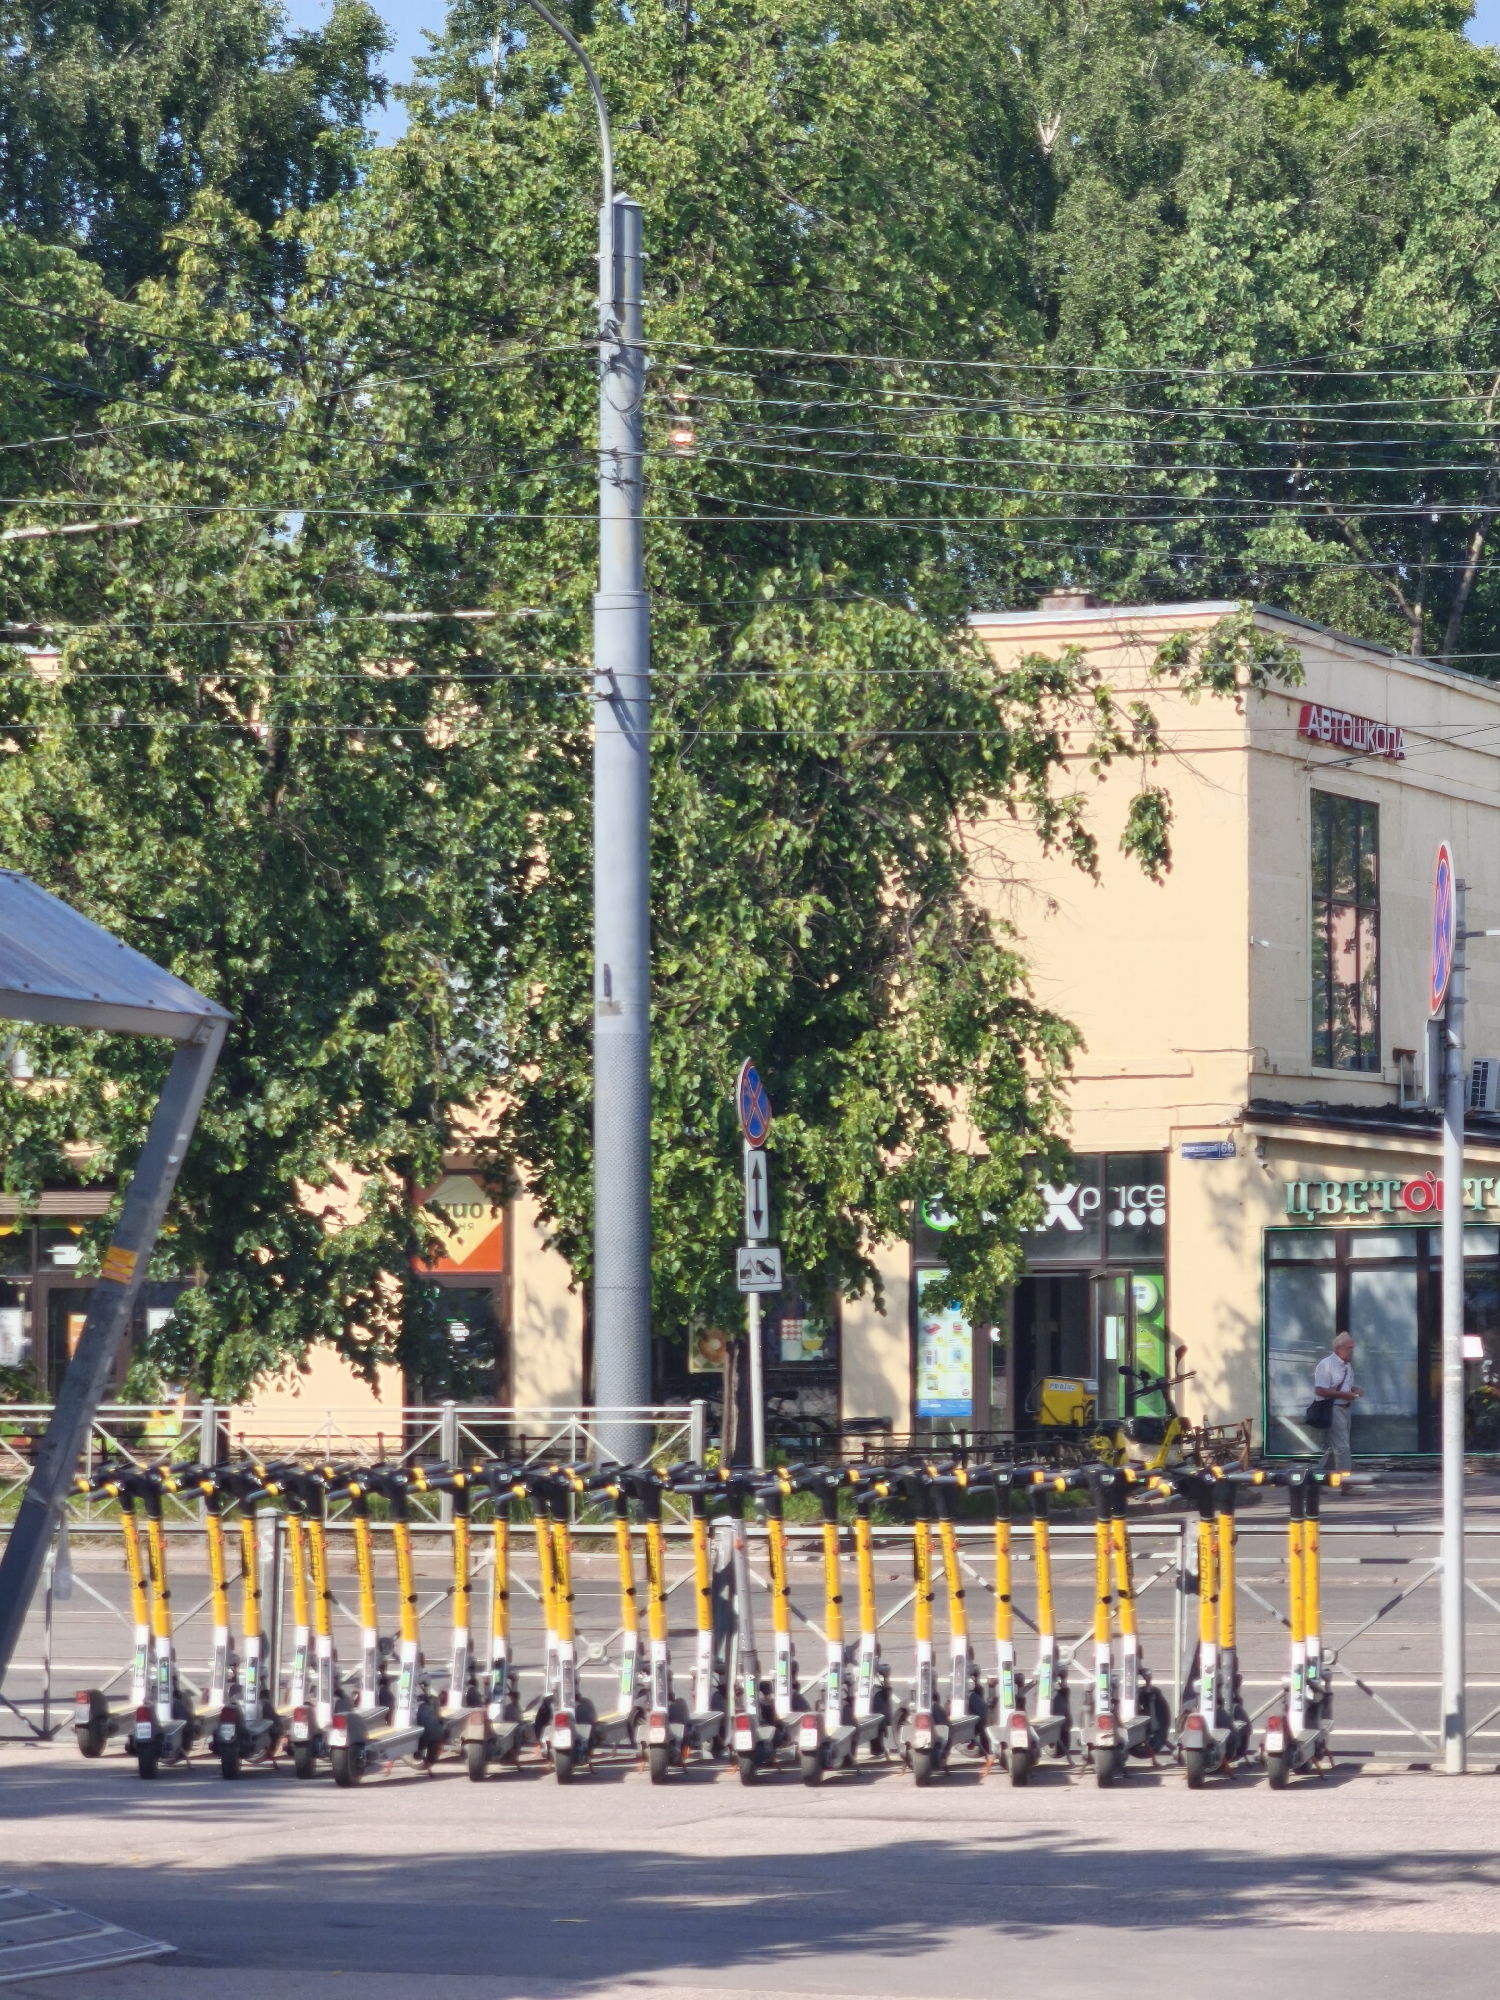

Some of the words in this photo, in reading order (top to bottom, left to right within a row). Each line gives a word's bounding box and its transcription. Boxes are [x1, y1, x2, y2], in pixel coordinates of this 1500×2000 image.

[1308, 705, 1404, 758] АВТОШКОЛА
[1221, 1143, 1235, 1154] 66
[312, 1532, 321, 1600] WHOOSH
[357, 1530, 367, 1594] WHOOSH
[771, 1532, 781, 1598] WHOOSH
[917, 1535, 926, 1604] WHOOSH
[1200, 1535, 1208, 1604] WHOOSH
